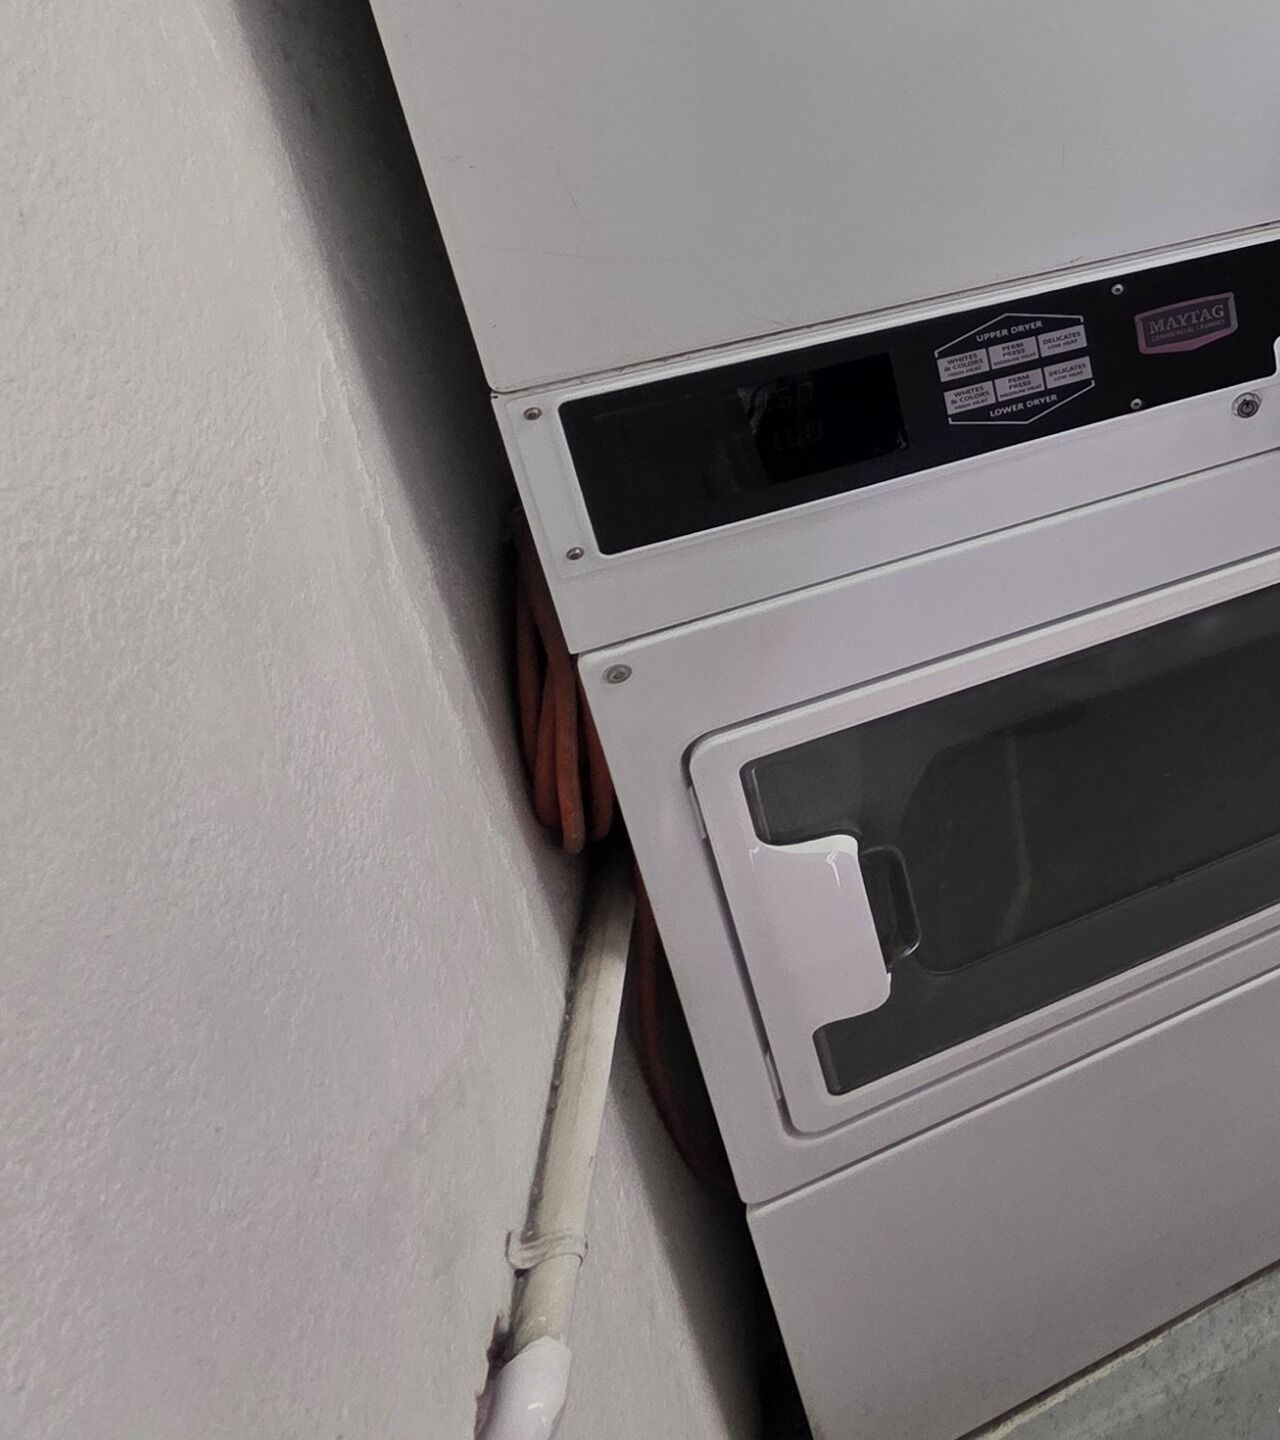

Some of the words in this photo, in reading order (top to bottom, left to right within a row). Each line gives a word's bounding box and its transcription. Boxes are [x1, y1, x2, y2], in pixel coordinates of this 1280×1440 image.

[1150, 304, 1224, 334] MAYTAG
[976, 328, 1008, 342] UPPER
[1011, 320, 1043, 334] DRYER
[1043, 331, 1081, 345] DELICATES
[947, 353, 978, 364] WHITES
[1002, 349, 1025, 357] PRESS
[953, 358, 984, 370] COLORS
[1049, 363, 1086, 377] DELICATES
[1009, 380, 1031, 390] PRESS
[954, 386, 984, 398] WHITES
[959, 391, 989, 403] COLORS
[990, 402, 1024, 417] LOWER
[1027, 394, 1058, 408] DRYER
